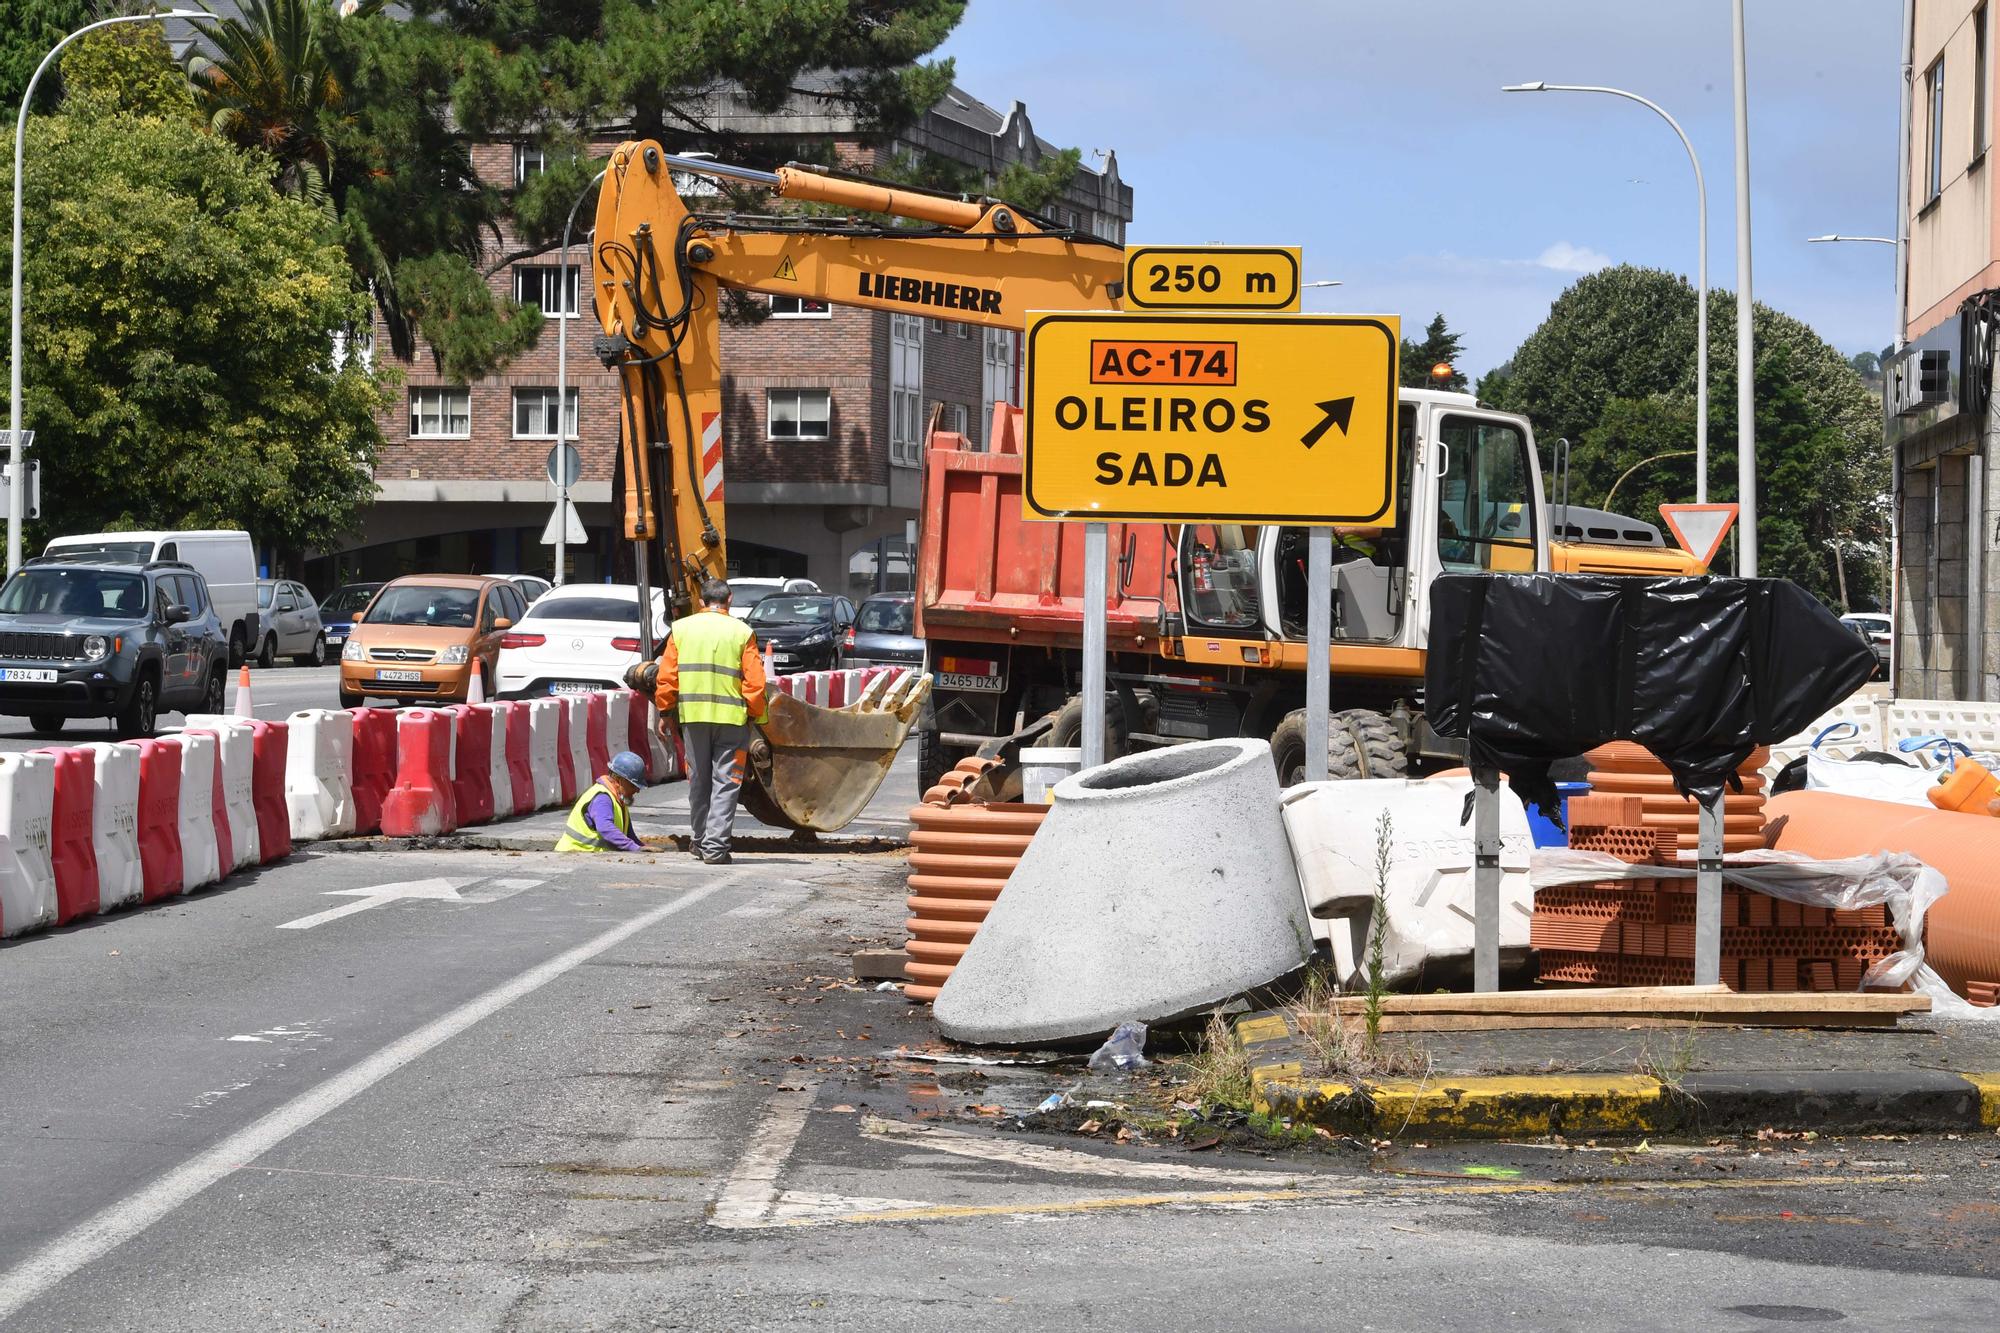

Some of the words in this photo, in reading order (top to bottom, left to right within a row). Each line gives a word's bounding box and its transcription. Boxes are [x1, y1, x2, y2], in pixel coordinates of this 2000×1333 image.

[858, 271, 1002, 315] LIEBHERR
[1149, 264, 1221, 293] 250
[1245, 272, 1276, 293] m
[1099, 348, 1228, 378] AC-174
[1055, 395, 1271, 433] OLEIROS
[1094, 452, 1227, 488] SADA
[7, 670, 31, 680] 7834
[36, 671, 56, 680] JWL
[383, 671, 403, 680] 4472
[404, 672, 420, 681] HSS
[556, 682, 579, 692] 4953
[942, 674, 973, 687] 3465
[975, 676, 999, 689] DZK
